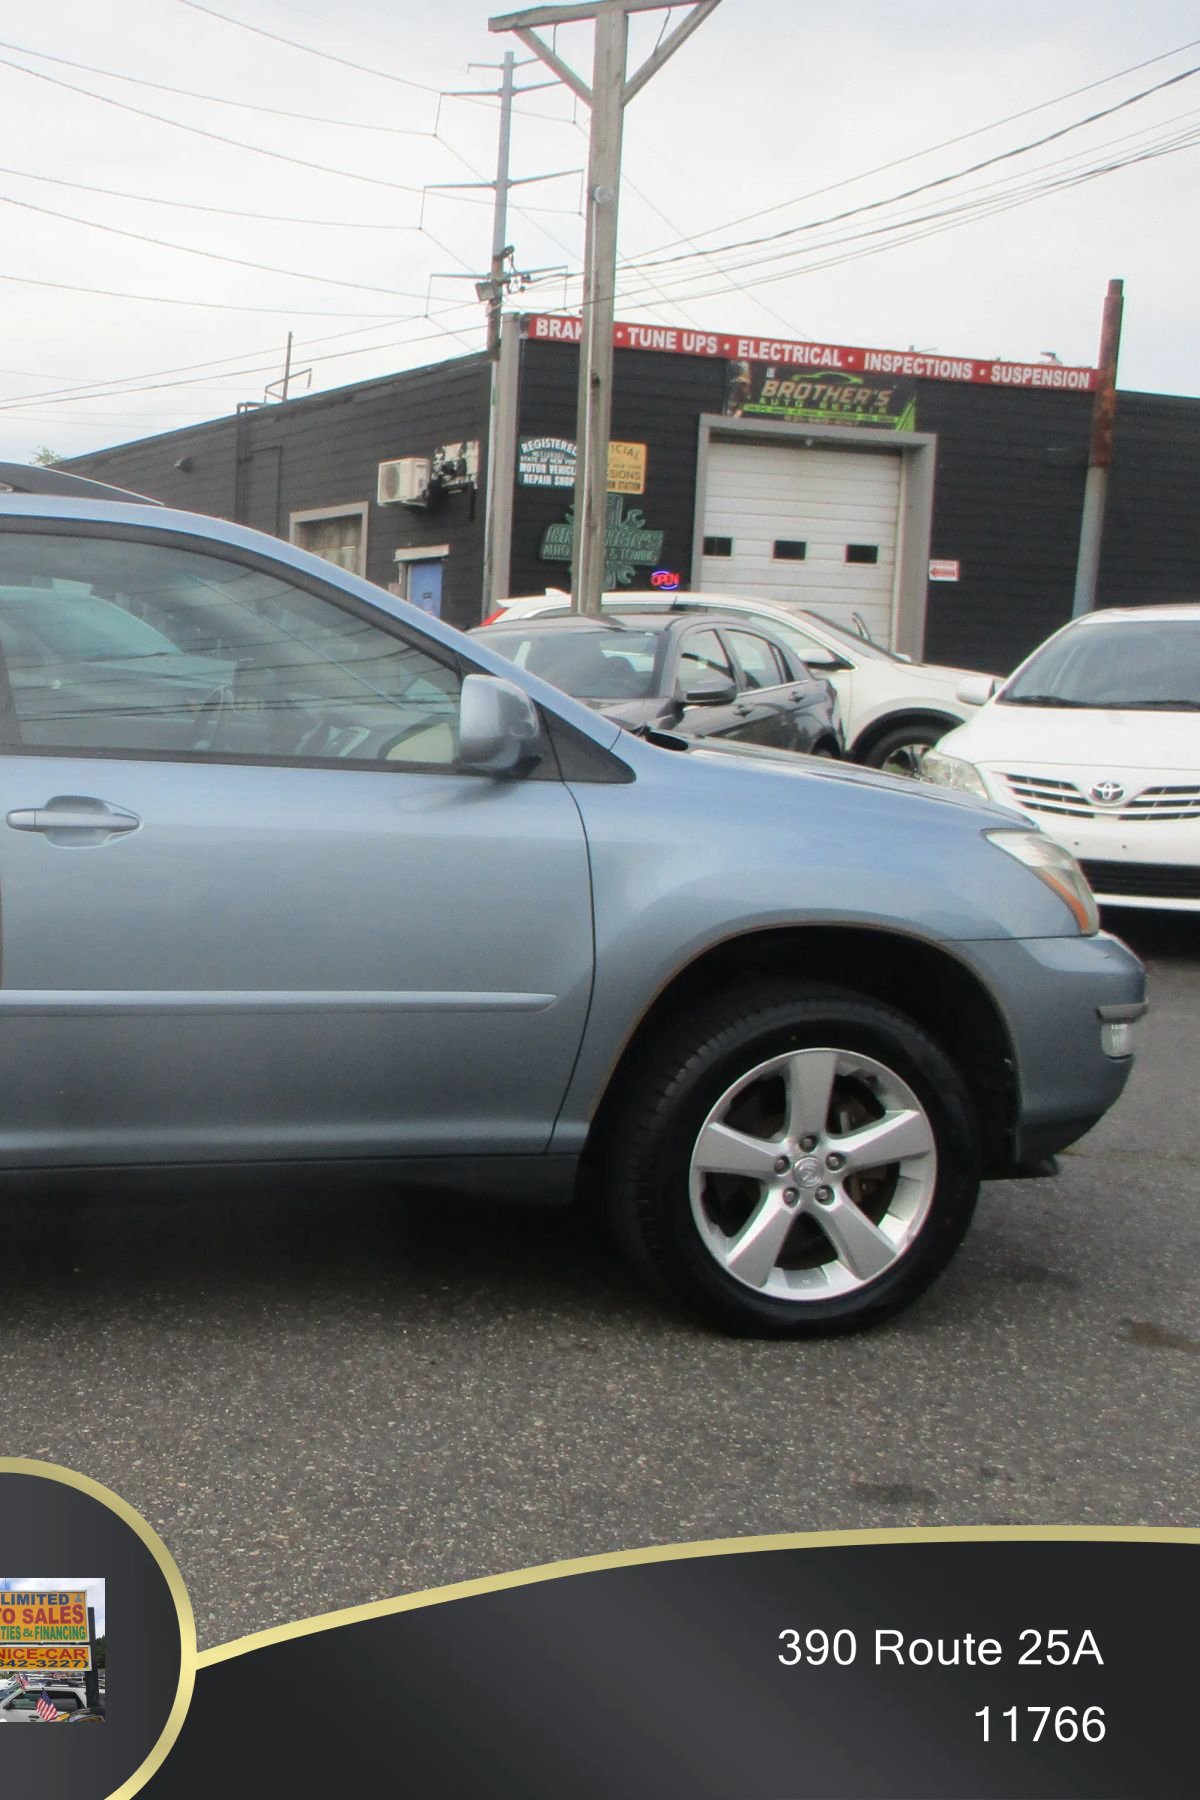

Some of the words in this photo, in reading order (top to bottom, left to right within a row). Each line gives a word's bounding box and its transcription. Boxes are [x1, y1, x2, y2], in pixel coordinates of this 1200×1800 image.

[536, 318, 582, 340] BRAK
[627, 327, 676, 350] TUNE
[682, 331, 717, 354] UPS
[737, 340, 842, 367] ELECTRICAL
[864, 352, 973, 379] INSPECTIONS
[990, 367, 1090, 389] SUSPENSION
[761, 380, 893, 406] BROTHER'S
[610, 443, 641, 460] ICIAL
[519, 463, 546, 474] MOTOR
[549, 465, 577, 476] VEHICL
[523, 474, 552, 485] REPAIR
[554, 476, 575, 487] SHOP
[651, 572, 680, 586] OPEN
